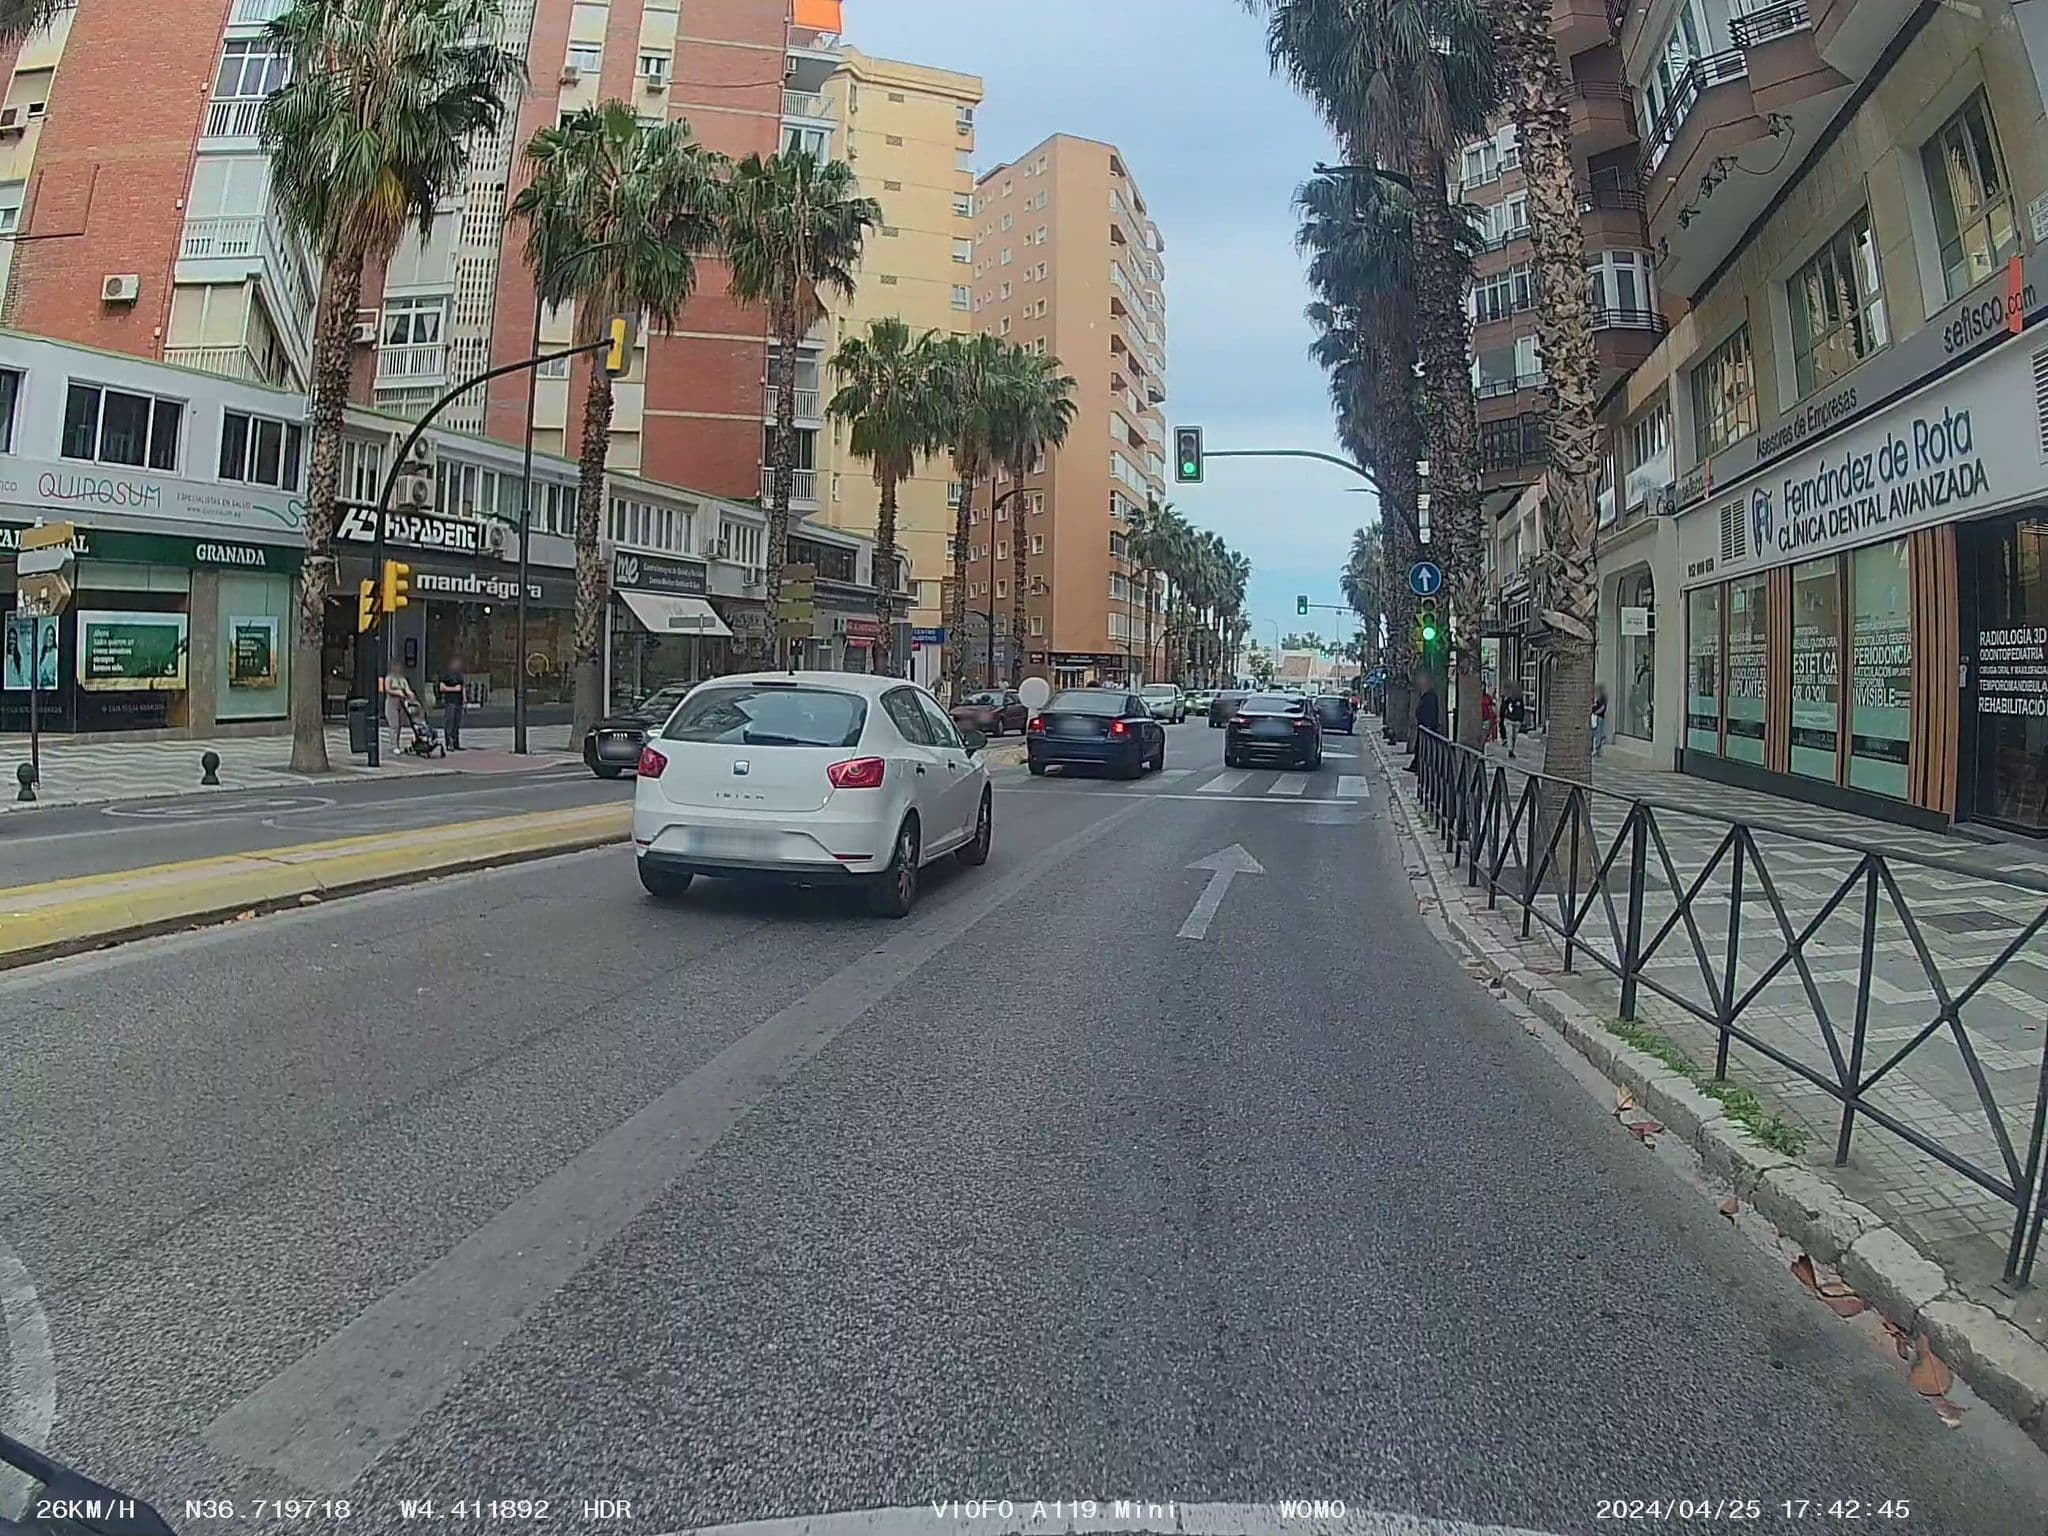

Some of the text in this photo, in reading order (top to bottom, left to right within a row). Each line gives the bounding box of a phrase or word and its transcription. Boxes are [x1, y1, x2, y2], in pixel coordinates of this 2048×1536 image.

[1944, 284, 2036, 354] sefisco.com
[1757, 387, 1857, 461] Asesores de Empresas
[1783, 406, 1973, 521] Fernández de Rota
[38, 472, 161, 509] QUIROSUM
[1778, 457, 1990, 553] CLÍNICA DENTAL AVANZADA
[196, 543, 266, 566] GRANADA
[1980, 624, 2047, 646] RADIOLOGÍA 3D
[1854, 645, 1912, 665] PERIODONCIA
[1853, 687, 1895, 707] INVISIBLE
[1978, 695, 2048, 716] REHABILITACIÓ
